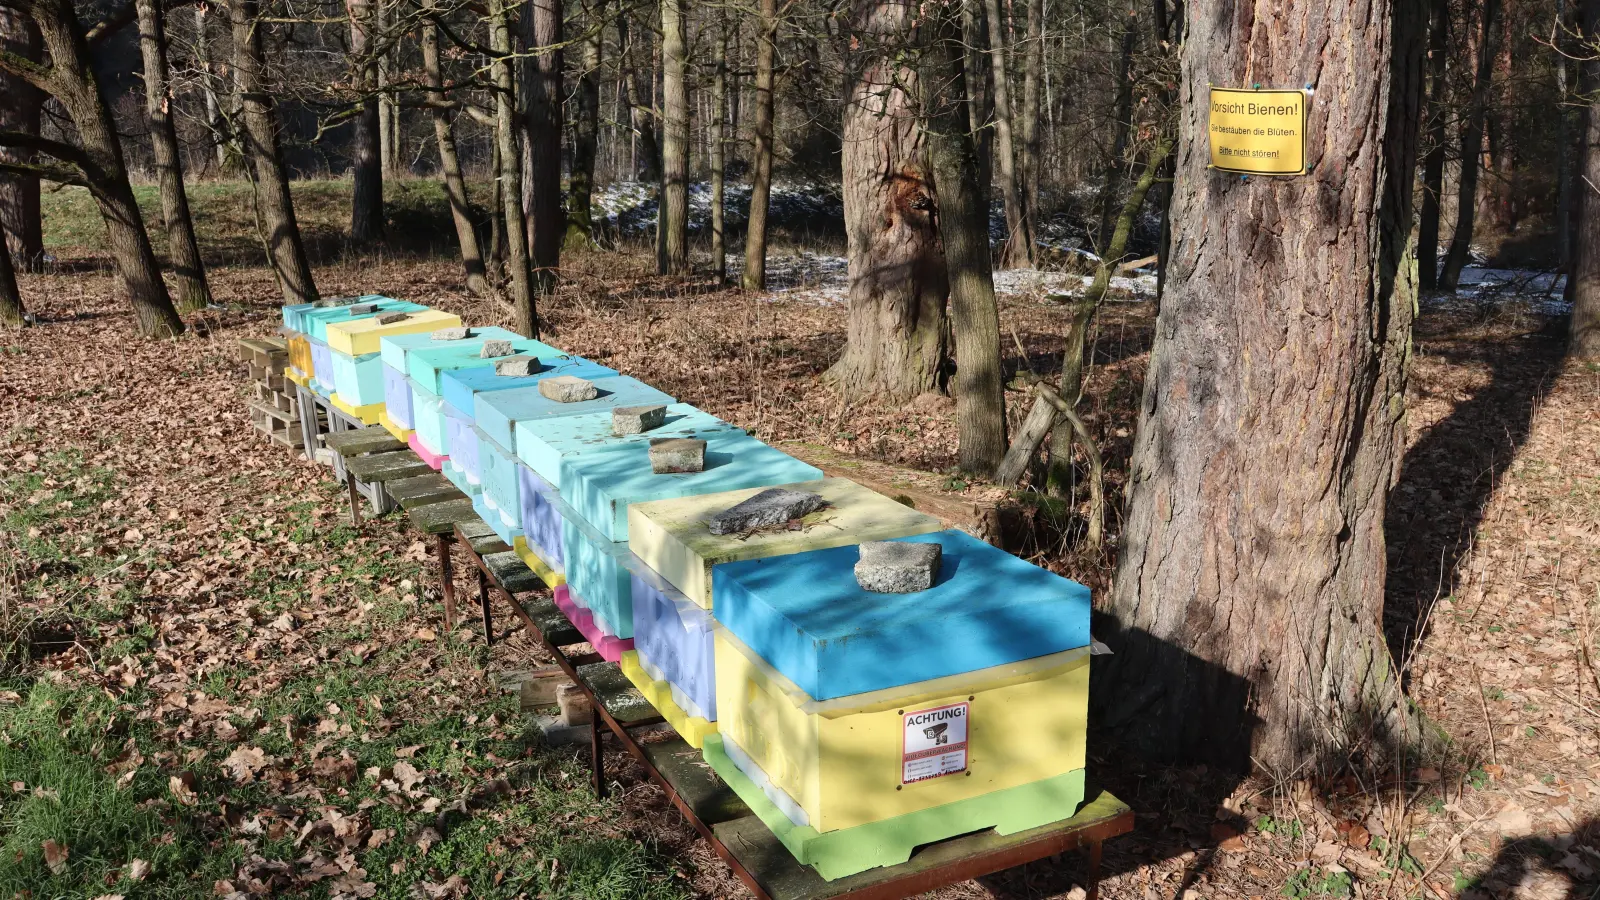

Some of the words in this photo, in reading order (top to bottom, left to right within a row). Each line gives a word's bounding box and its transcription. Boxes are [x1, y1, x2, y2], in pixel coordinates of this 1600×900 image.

[1248, 103, 1298, 116] Bienen!
[1218, 124, 1251, 135] bestäuben
[1253, 128, 1265, 136] die
[1267, 128, 1297, 136] Blüten.
[1219, 146, 1232, 155] Bitte
[1234, 147, 1250, 156] nicht
[1252, 149, 1280, 158] stören!
[907, 706, 966, 727] ACHTUNG!
